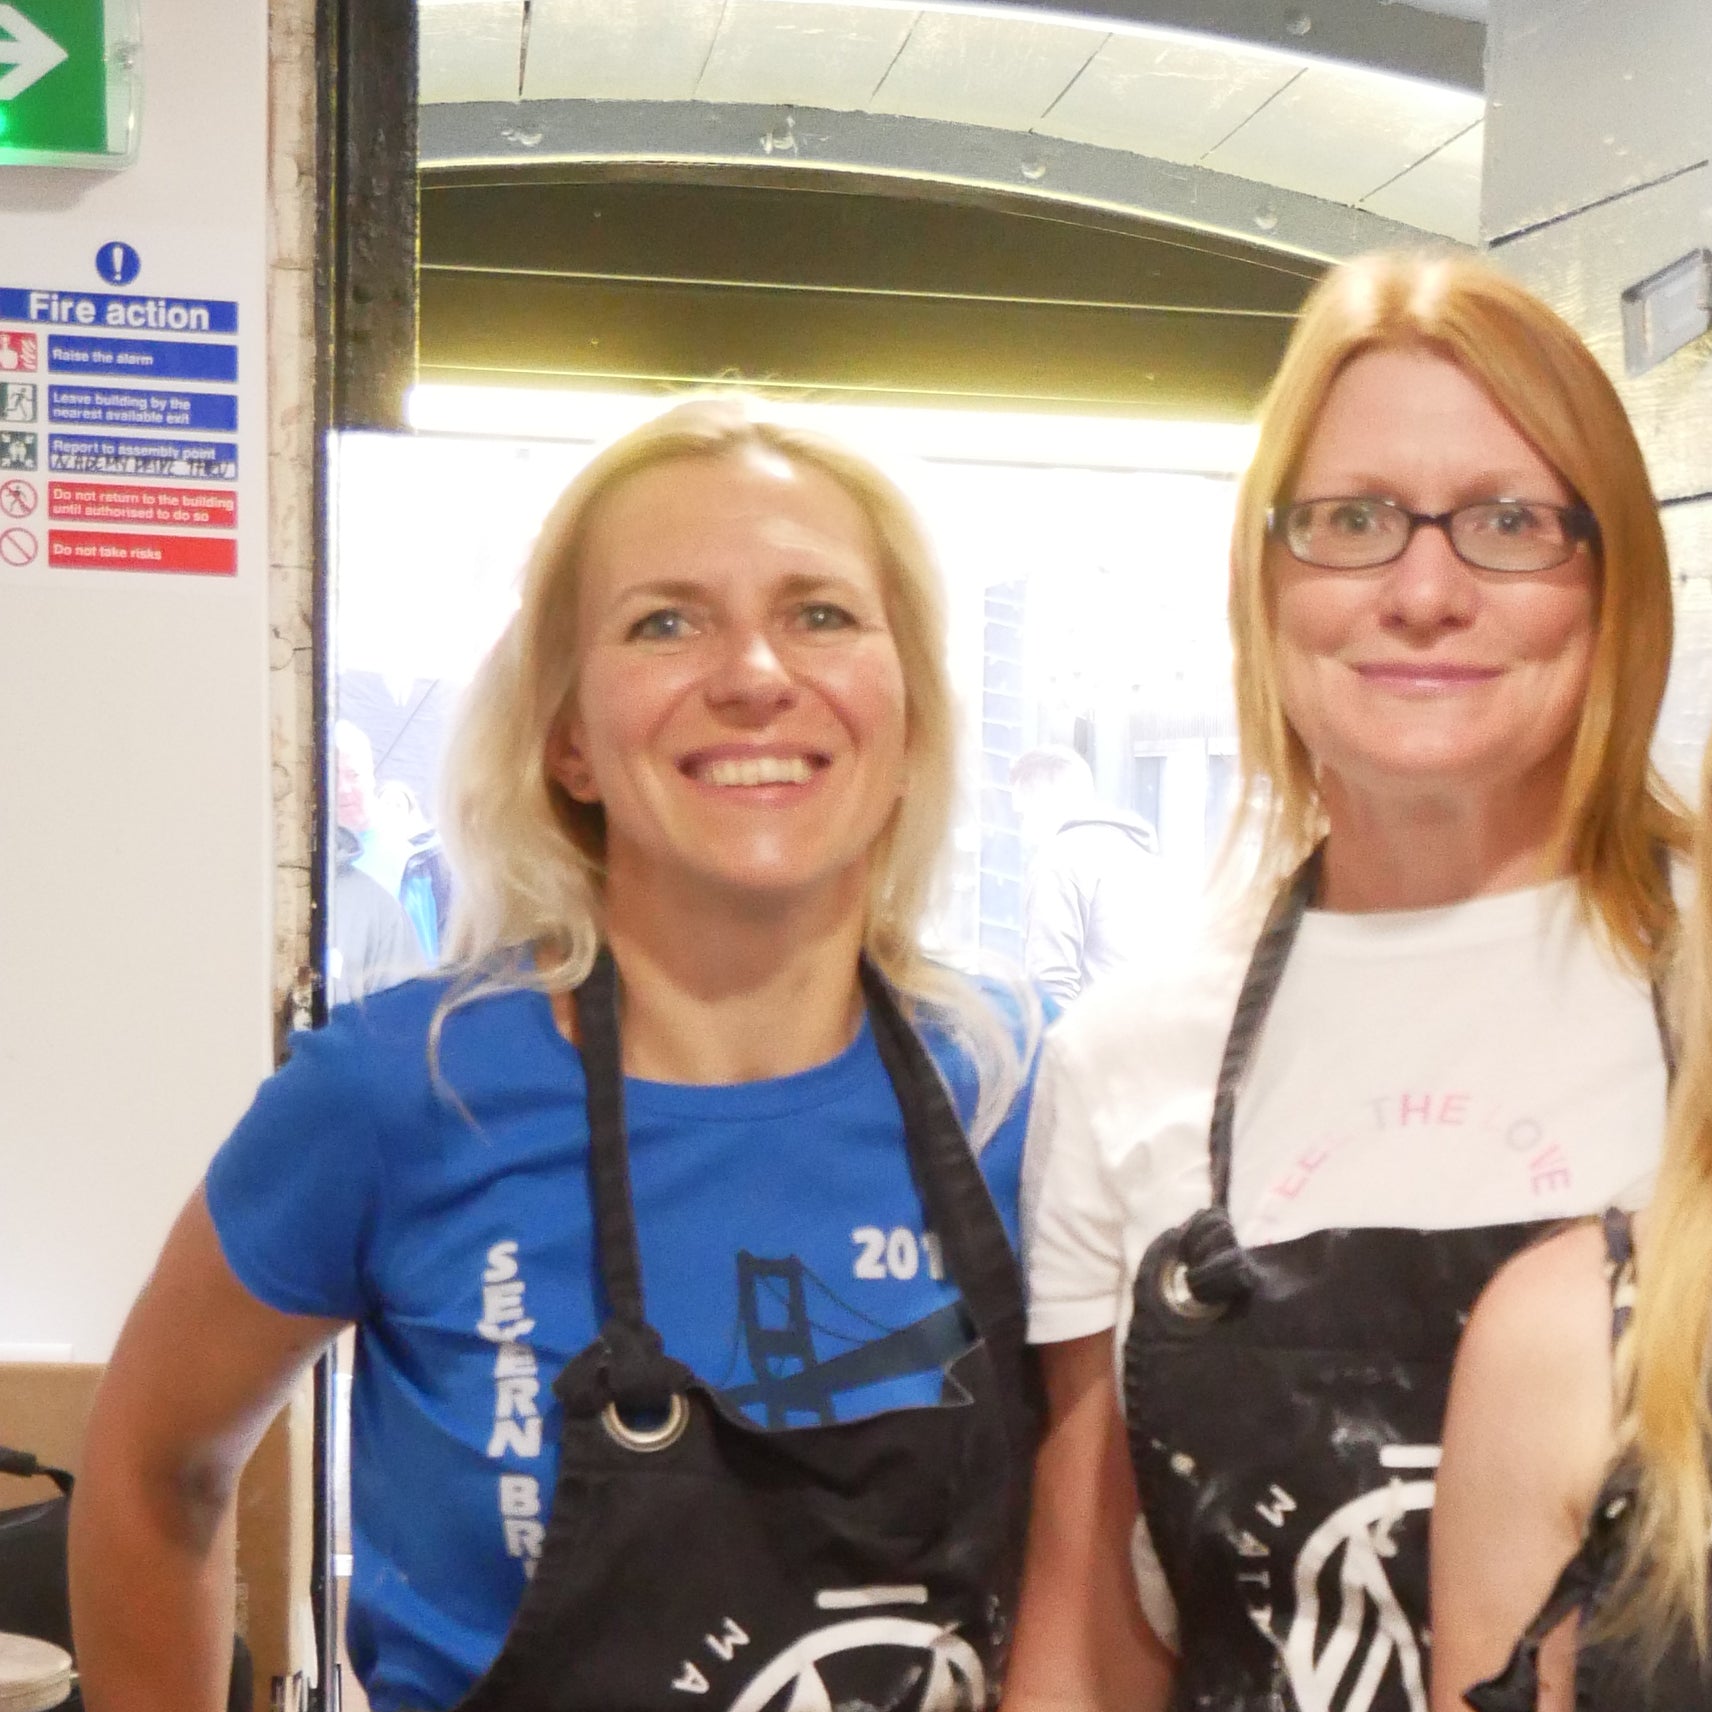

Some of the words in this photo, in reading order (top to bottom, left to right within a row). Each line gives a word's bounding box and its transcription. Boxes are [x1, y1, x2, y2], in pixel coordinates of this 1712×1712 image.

[29, 292, 96, 324] Fire
[106, 300, 210, 331] action
[52, 348, 89, 363] Raise
[92, 351, 114, 363] the
[116, 352, 154, 365] alarm
[53, 391, 91, 405] Leave
[95, 393, 147, 410] building
[151, 397, 167, 411] by
[170, 398, 191, 411] the
[53, 408, 102, 420] nearest
[105, 410, 163, 424] available
[166, 412, 190, 425] exit
[53, 440, 98, 456] Report
[102, 443, 115, 455] to
[118, 444, 179, 460] assembly
[182, 448, 215, 461] point
[53, 488, 72, 501] Do
[75, 491, 96, 502] not
[100, 493, 139, 504] return
[142, 493, 155, 505] to
[158, 494, 179, 506] the
[182, 495, 234, 511] building
[53, 504, 81, 515] until
[85, 505, 154, 519] authorised
[157, 508, 170, 520] to
[173, 509, 190, 521] do
[193, 511, 209, 522] so
[53, 543, 72, 555] Do
[75, 545, 97, 556] not
[100, 546, 127, 558] take
[130, 548, 162, 560] risks
[1368, 1091, 1472, 1130] THE
[476, 1240, 542, 1459] SEVERN
[499, 1474, 546, 1582] BR
